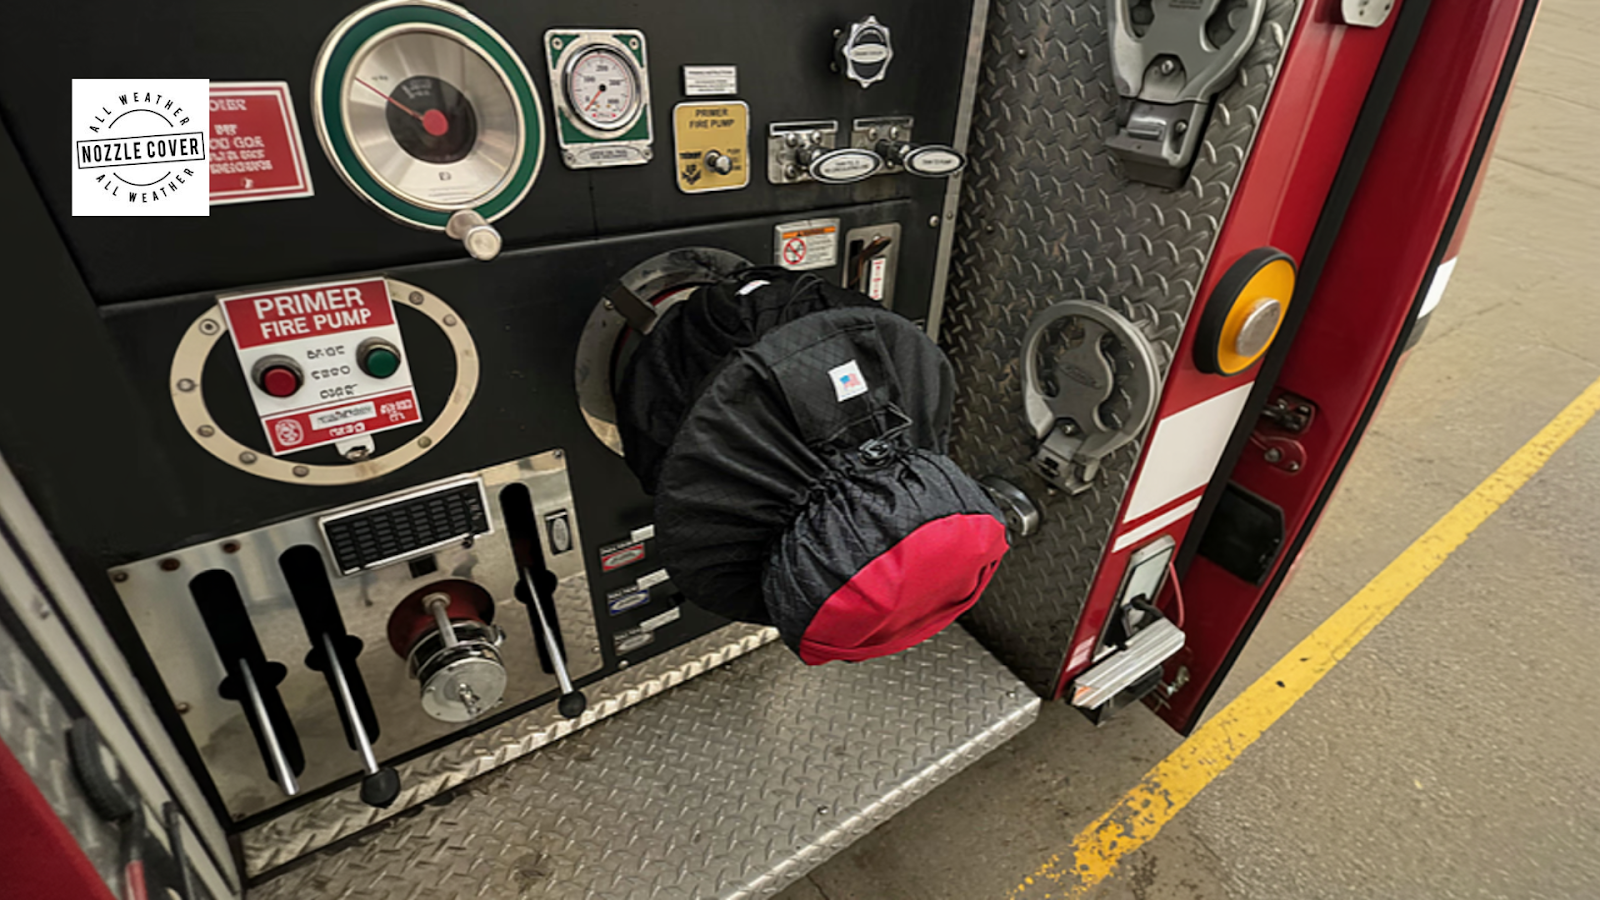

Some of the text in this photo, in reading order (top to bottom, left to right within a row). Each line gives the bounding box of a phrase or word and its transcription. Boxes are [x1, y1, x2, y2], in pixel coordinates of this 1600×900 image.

[695, 108, 729, 118] PRIMER
[689, 119, 735, 129] FIRE PUMP
[253, 287, 365, 320] PRIMER
[260, 308, 371, 339] FIRE PUMP
